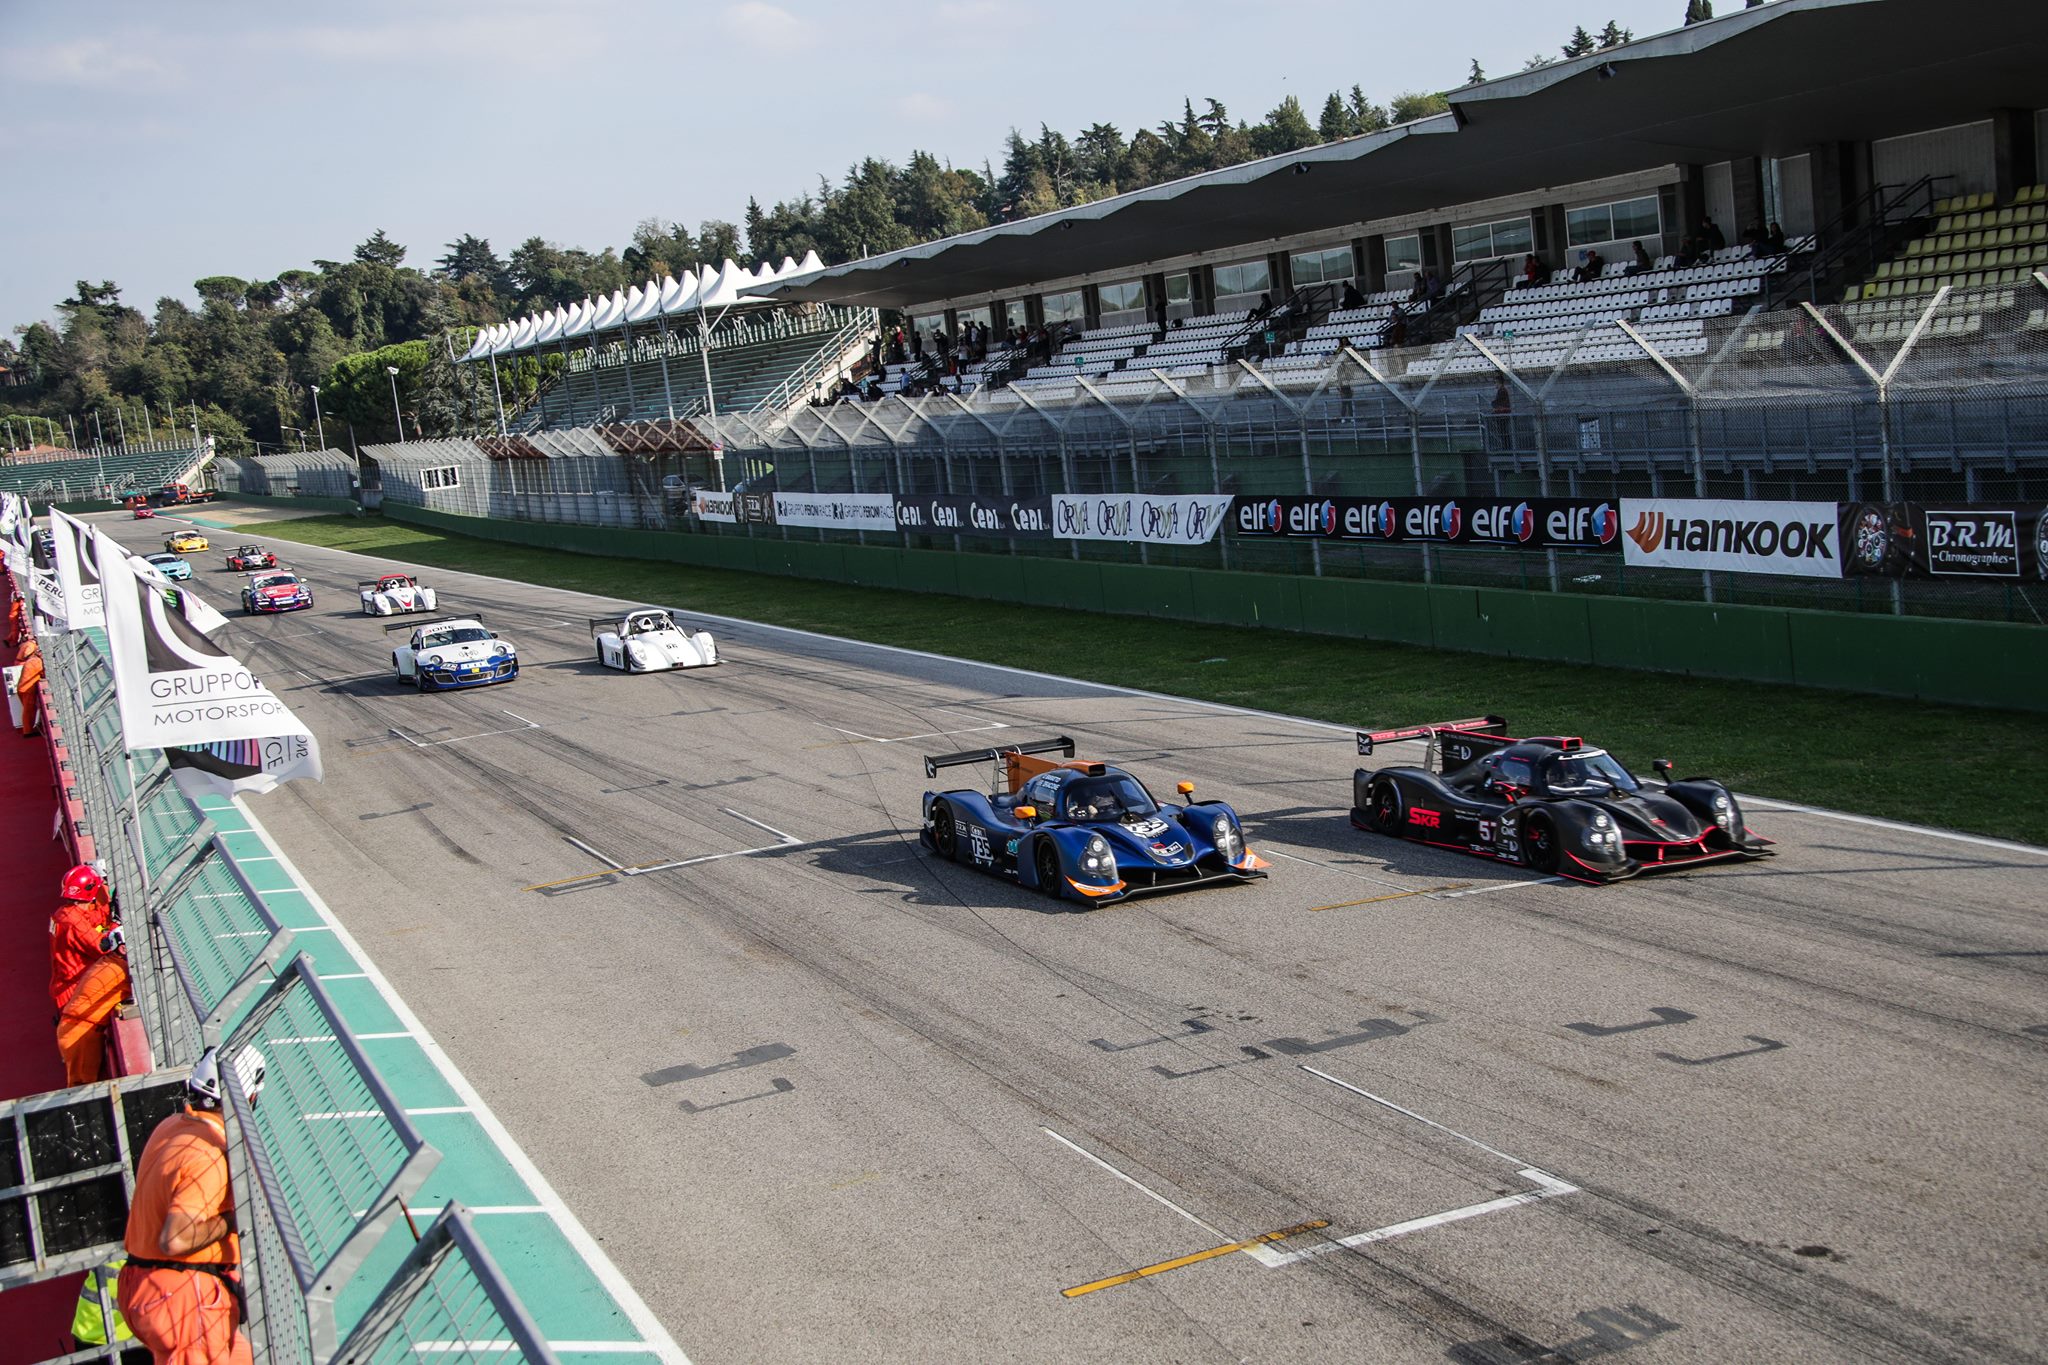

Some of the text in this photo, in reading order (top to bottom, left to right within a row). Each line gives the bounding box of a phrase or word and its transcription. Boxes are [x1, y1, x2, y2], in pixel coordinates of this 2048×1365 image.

[1240, 503, 1267, 530] elf
[1290, 503, 1319, 531] elf
[1344, 504, 1377, 534] elf
[1405, 504, 1441, 536] elf
[1471, 506, 1512, 537] elf
[1547, 507, 1590, 540] elf
[1408, 806, 1440, 829] SKR
[971, 836, 993, 858] 735
